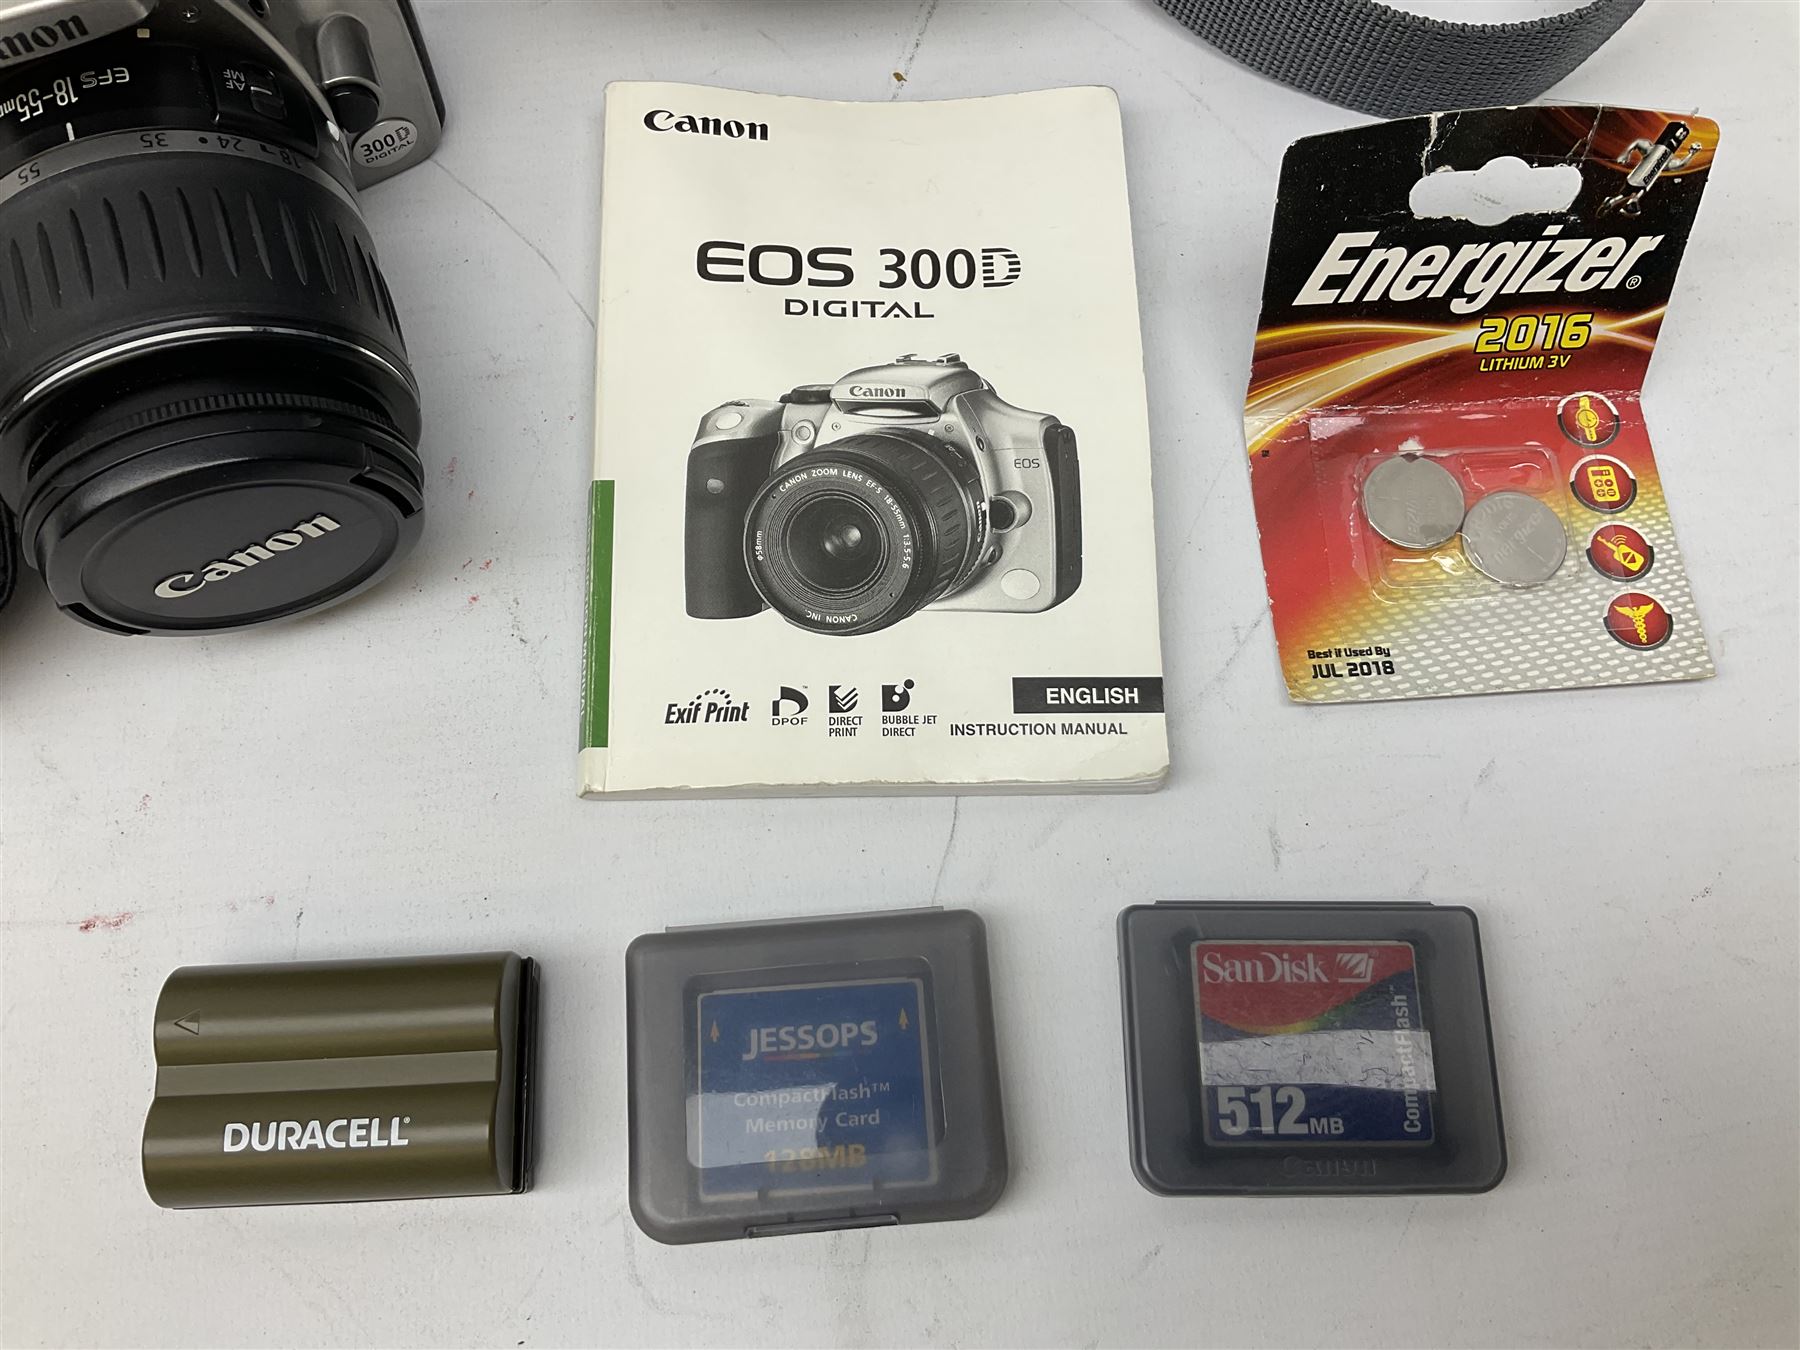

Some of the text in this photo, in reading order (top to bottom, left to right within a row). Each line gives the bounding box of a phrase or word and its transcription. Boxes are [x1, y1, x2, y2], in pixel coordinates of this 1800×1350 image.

[80, 67, 130, 88] EFS
[223, 68, 245, 82] MF
[226, 80, 246, 91] AF
[644, 109, 769, 141] Canon
[361, 126, 410, 157] 300D
[18, 162, 41, 186] 55
[140, 132, 169, 148] 35
[217, 135, 242, 150] 24
[366, 140, 414, 164] DIGITAL
[696, 240, 1022, 290] EOS 300D
[784, 298, 935, 319] DIGITAL
[1474, 312, 1594, 354] 2016
[1480, 354, 1571, 372] LITHIUM 3V
[849, 384, 906, 398] Canon
[1014, 457, 1040, 469] EOS
[779, 473, 808, 492] CANON
[811, 468, 838, 477] ZOOM
[842, 470, 863, 482] LENS
[865, 479, 883, 494] EF-S
[884, 494, 906, 529] 18-55mm
[155, 512, 342, 598] Canon
[826, 614, 858, 624] CANON
[1307, 646, 1391, 659] Best if Used By
[1312, 660, 1395, 679] JUL 2018
[1046, 687, 1139, 704] ENGLISH
[664, 699, 750, 724] Exif Print
[771, 717, 808, 726] DPOF
[828, 716, 863, 726] DIRECT
[882, 715, 938, 725] BUBBLE JET
[828, 727, 858, 737] PRINT
[882, 727, 916, 737] DIRECT
[950, 722, 1128, 736] INSTRUCTION MANUAL
[1202, 951, 1329, 984] SanDisk
[742, 1020, 879, 1061] JESSOPS
[745, 1108, 880, 1133] Memory Card
[764, 1143, 868, 1173] 128MB
